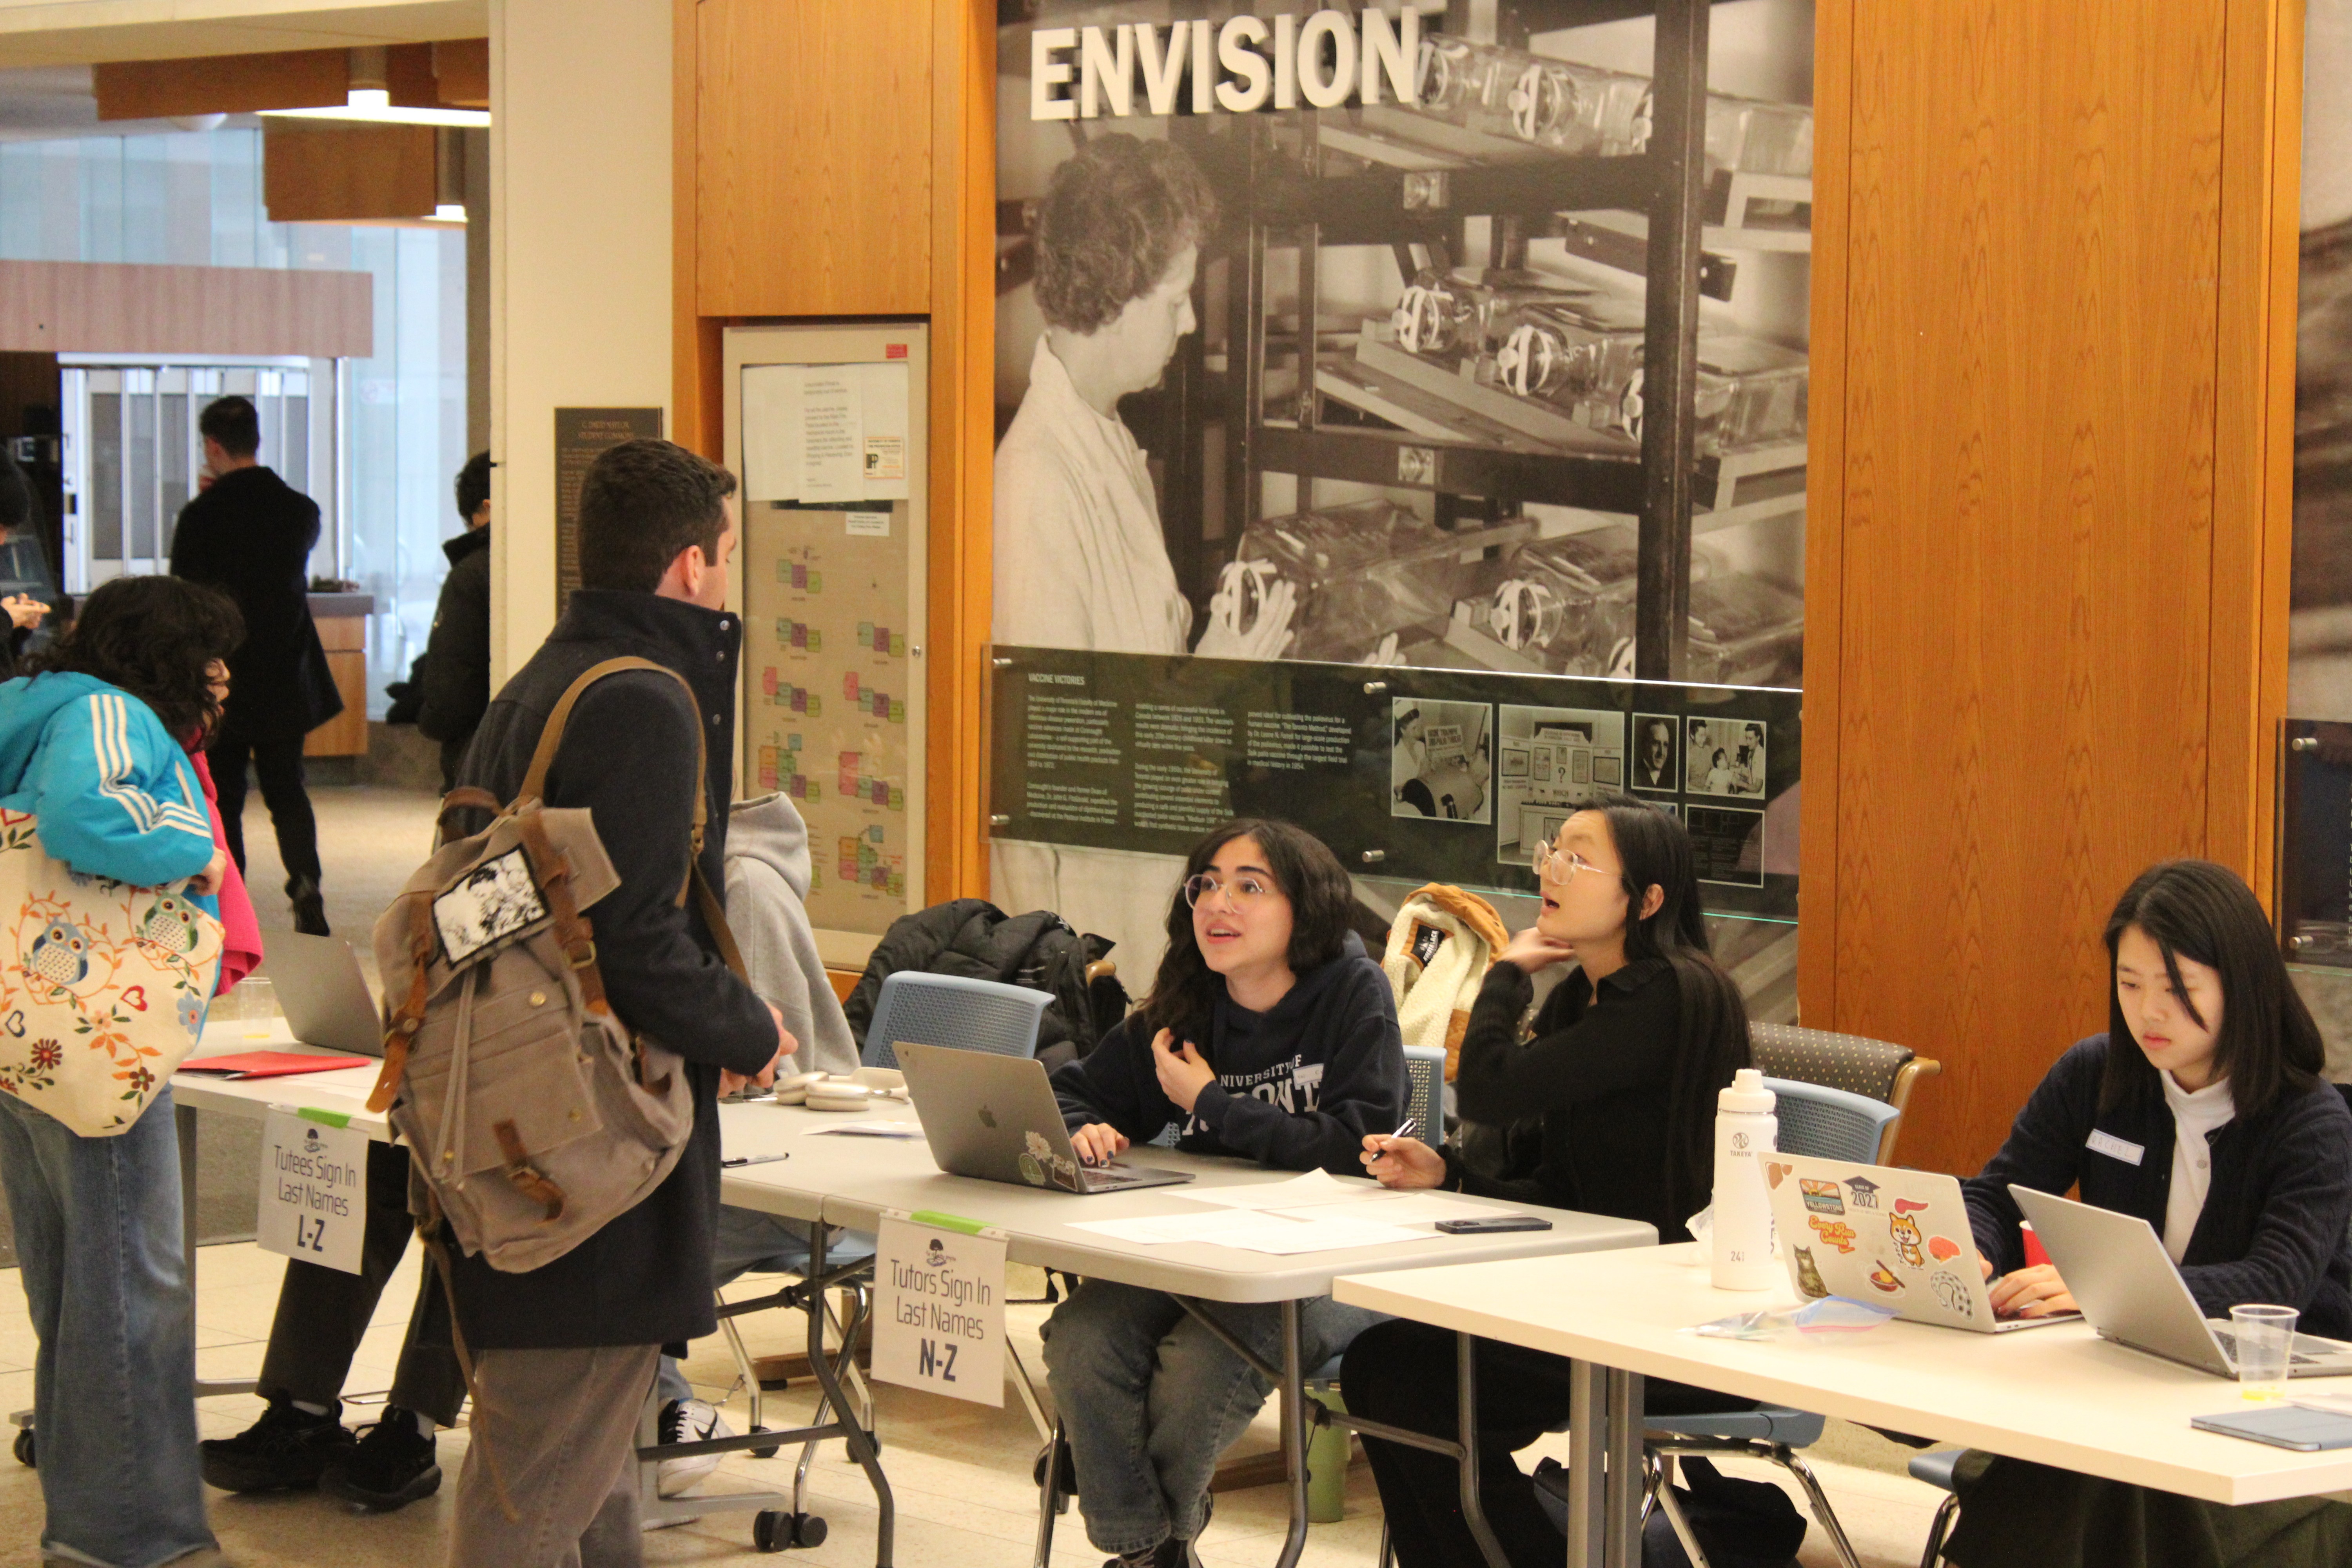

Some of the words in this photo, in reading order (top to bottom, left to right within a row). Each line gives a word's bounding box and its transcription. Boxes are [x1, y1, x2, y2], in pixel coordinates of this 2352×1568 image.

[1031, 5, 1418, 120] ENVISION
[1028, 673, 1054, 683] VACCINE
[1054, 675, 1085, 685] VICTORIES
[1220, 1061, 1294, 1087] NIVERSITY
[2092, 1136, 2133, 1158] RACHEL
[274, 1145, 313, 1177] Tutees
[316, 1156, 341, 1188] Sign
[345, 1163, 356, 1187] In
[279, 1177, 303, 1205] Last
[306, 1184, 348, 1216] Names
[1806, 1201, 1843, 1211] YELLOWSTONE
[1851, 1191, 1879, 1209] 2027
[1809, 1216, 1833, 1233] Every
[1835, 1222, 1856, 1237] Run
[1821, 1230, 1849, 1246] Counts
[1731, 1251, 1740, 1261] 24
[891, 1259, 936, 1295] Tutors
[941, 1269, 972, 1307] Sign
[977, 1277, 990, 1306] In
[897, 1295, 927, 1328] Last
[931, 1303, 984, 1340] Names
[919, 1338, 958, 1382] N-Z
